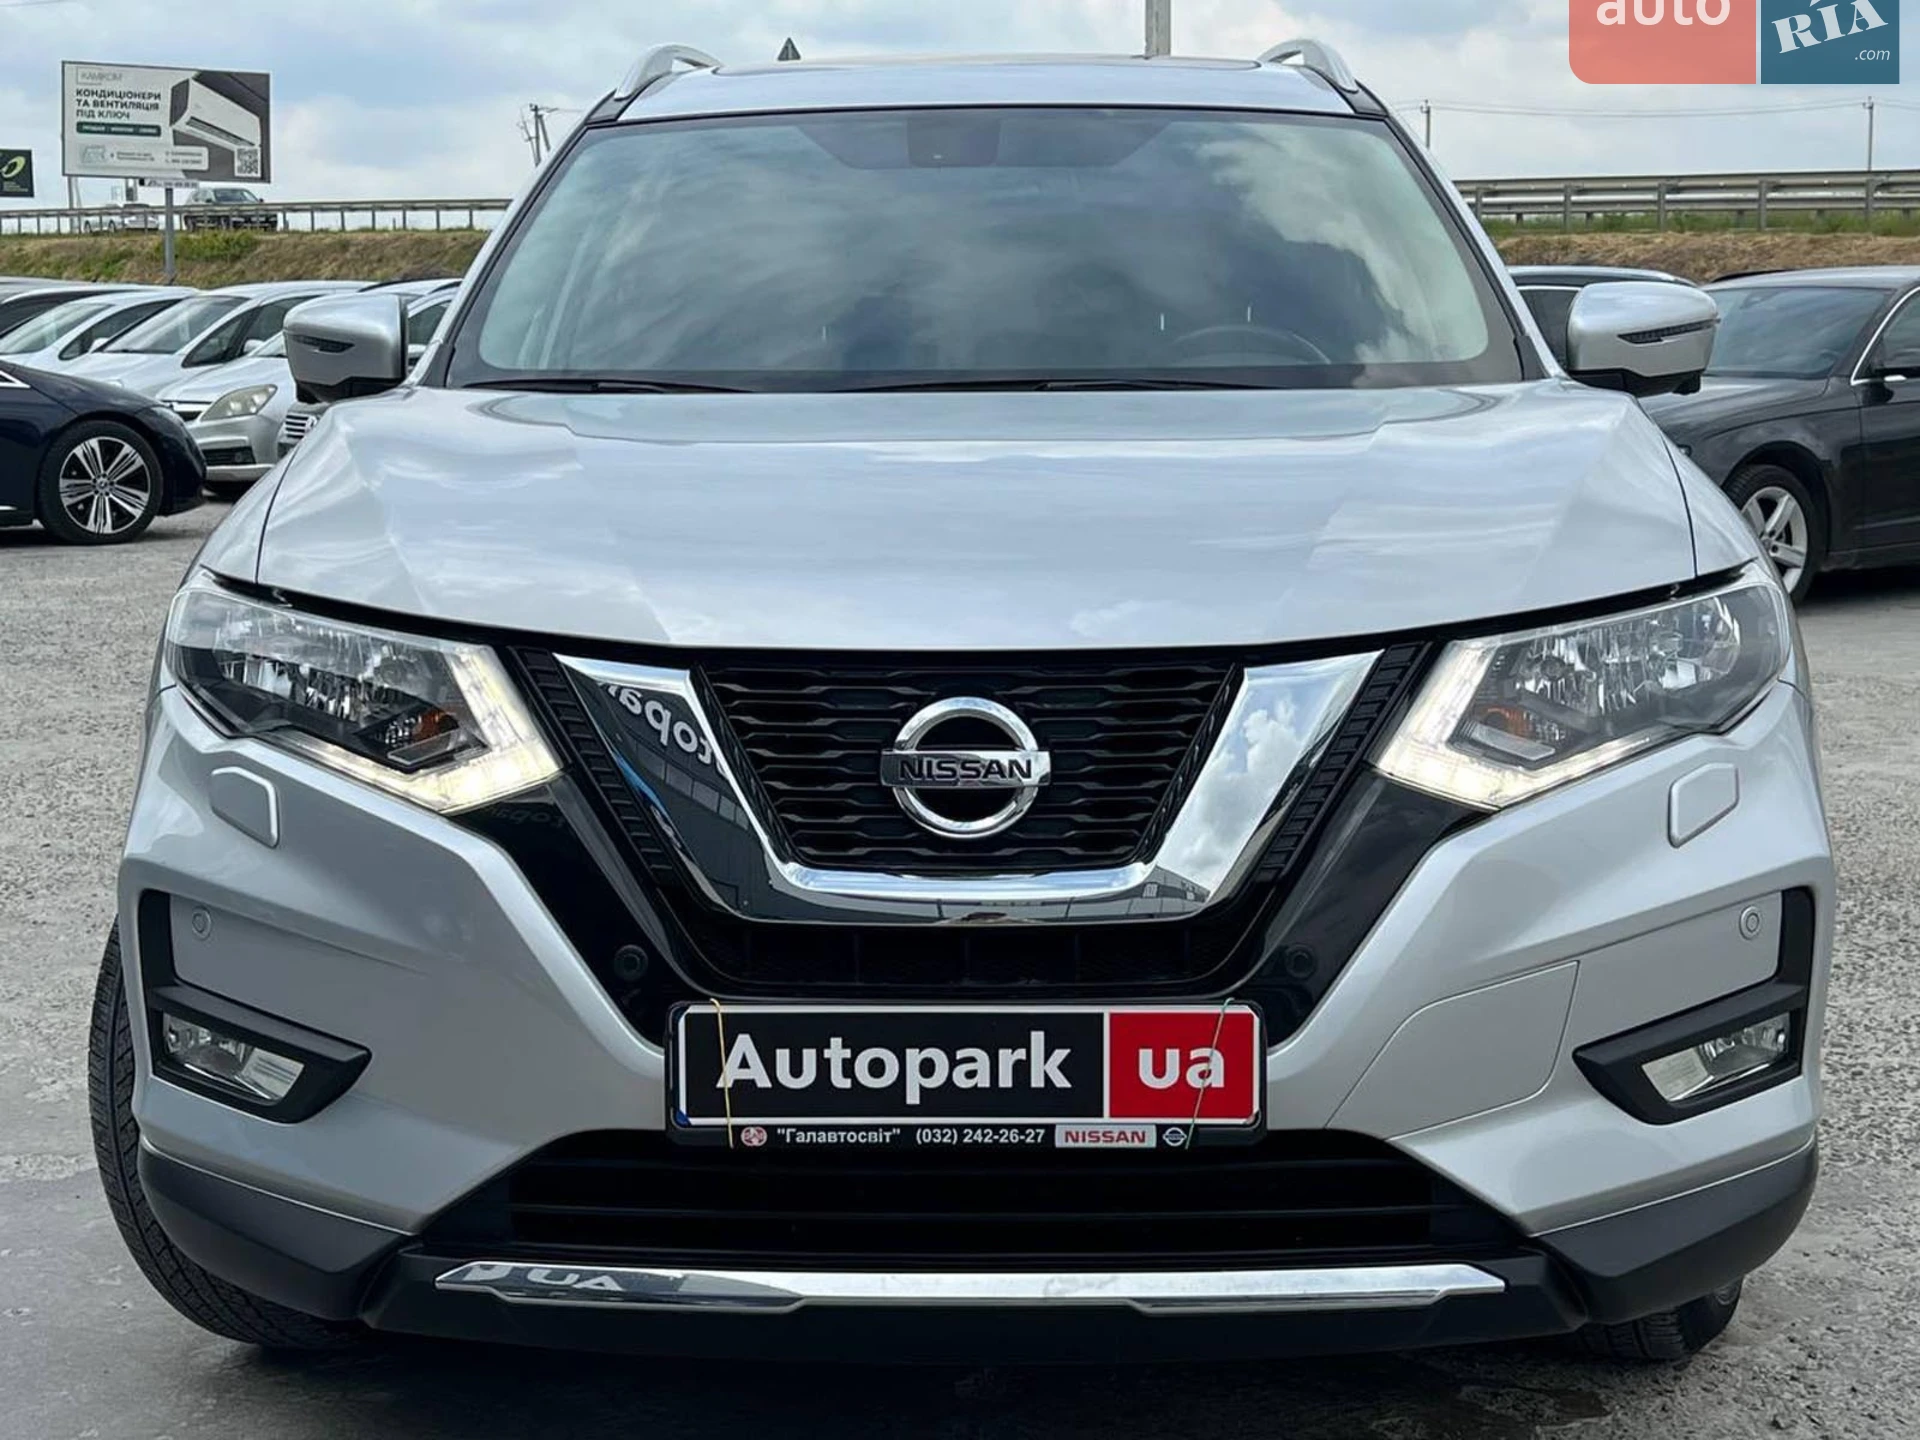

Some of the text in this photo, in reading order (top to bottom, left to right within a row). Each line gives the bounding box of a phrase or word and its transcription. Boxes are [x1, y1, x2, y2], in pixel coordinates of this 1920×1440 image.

[76, 89, 161, 100] КОНДИЦІОНЕРИ
[76, 99, 160, 111] ТА ВЕНТИЛЯЦІЯ
[76, 109, 130, 119] ПІД КЛЮЧ
[900, 759, 1032, 779] NISSAN
[716, 1030, 1226, 1105] Autopark ua
[777, 1128, 900, 1144] "Галавтосвіт"
[916, 1128, 958, 1146] (032)
[963, 1128, 1046, 1144] 242-26-27
[1065, 1131, 1146, 1144] NISSAN
